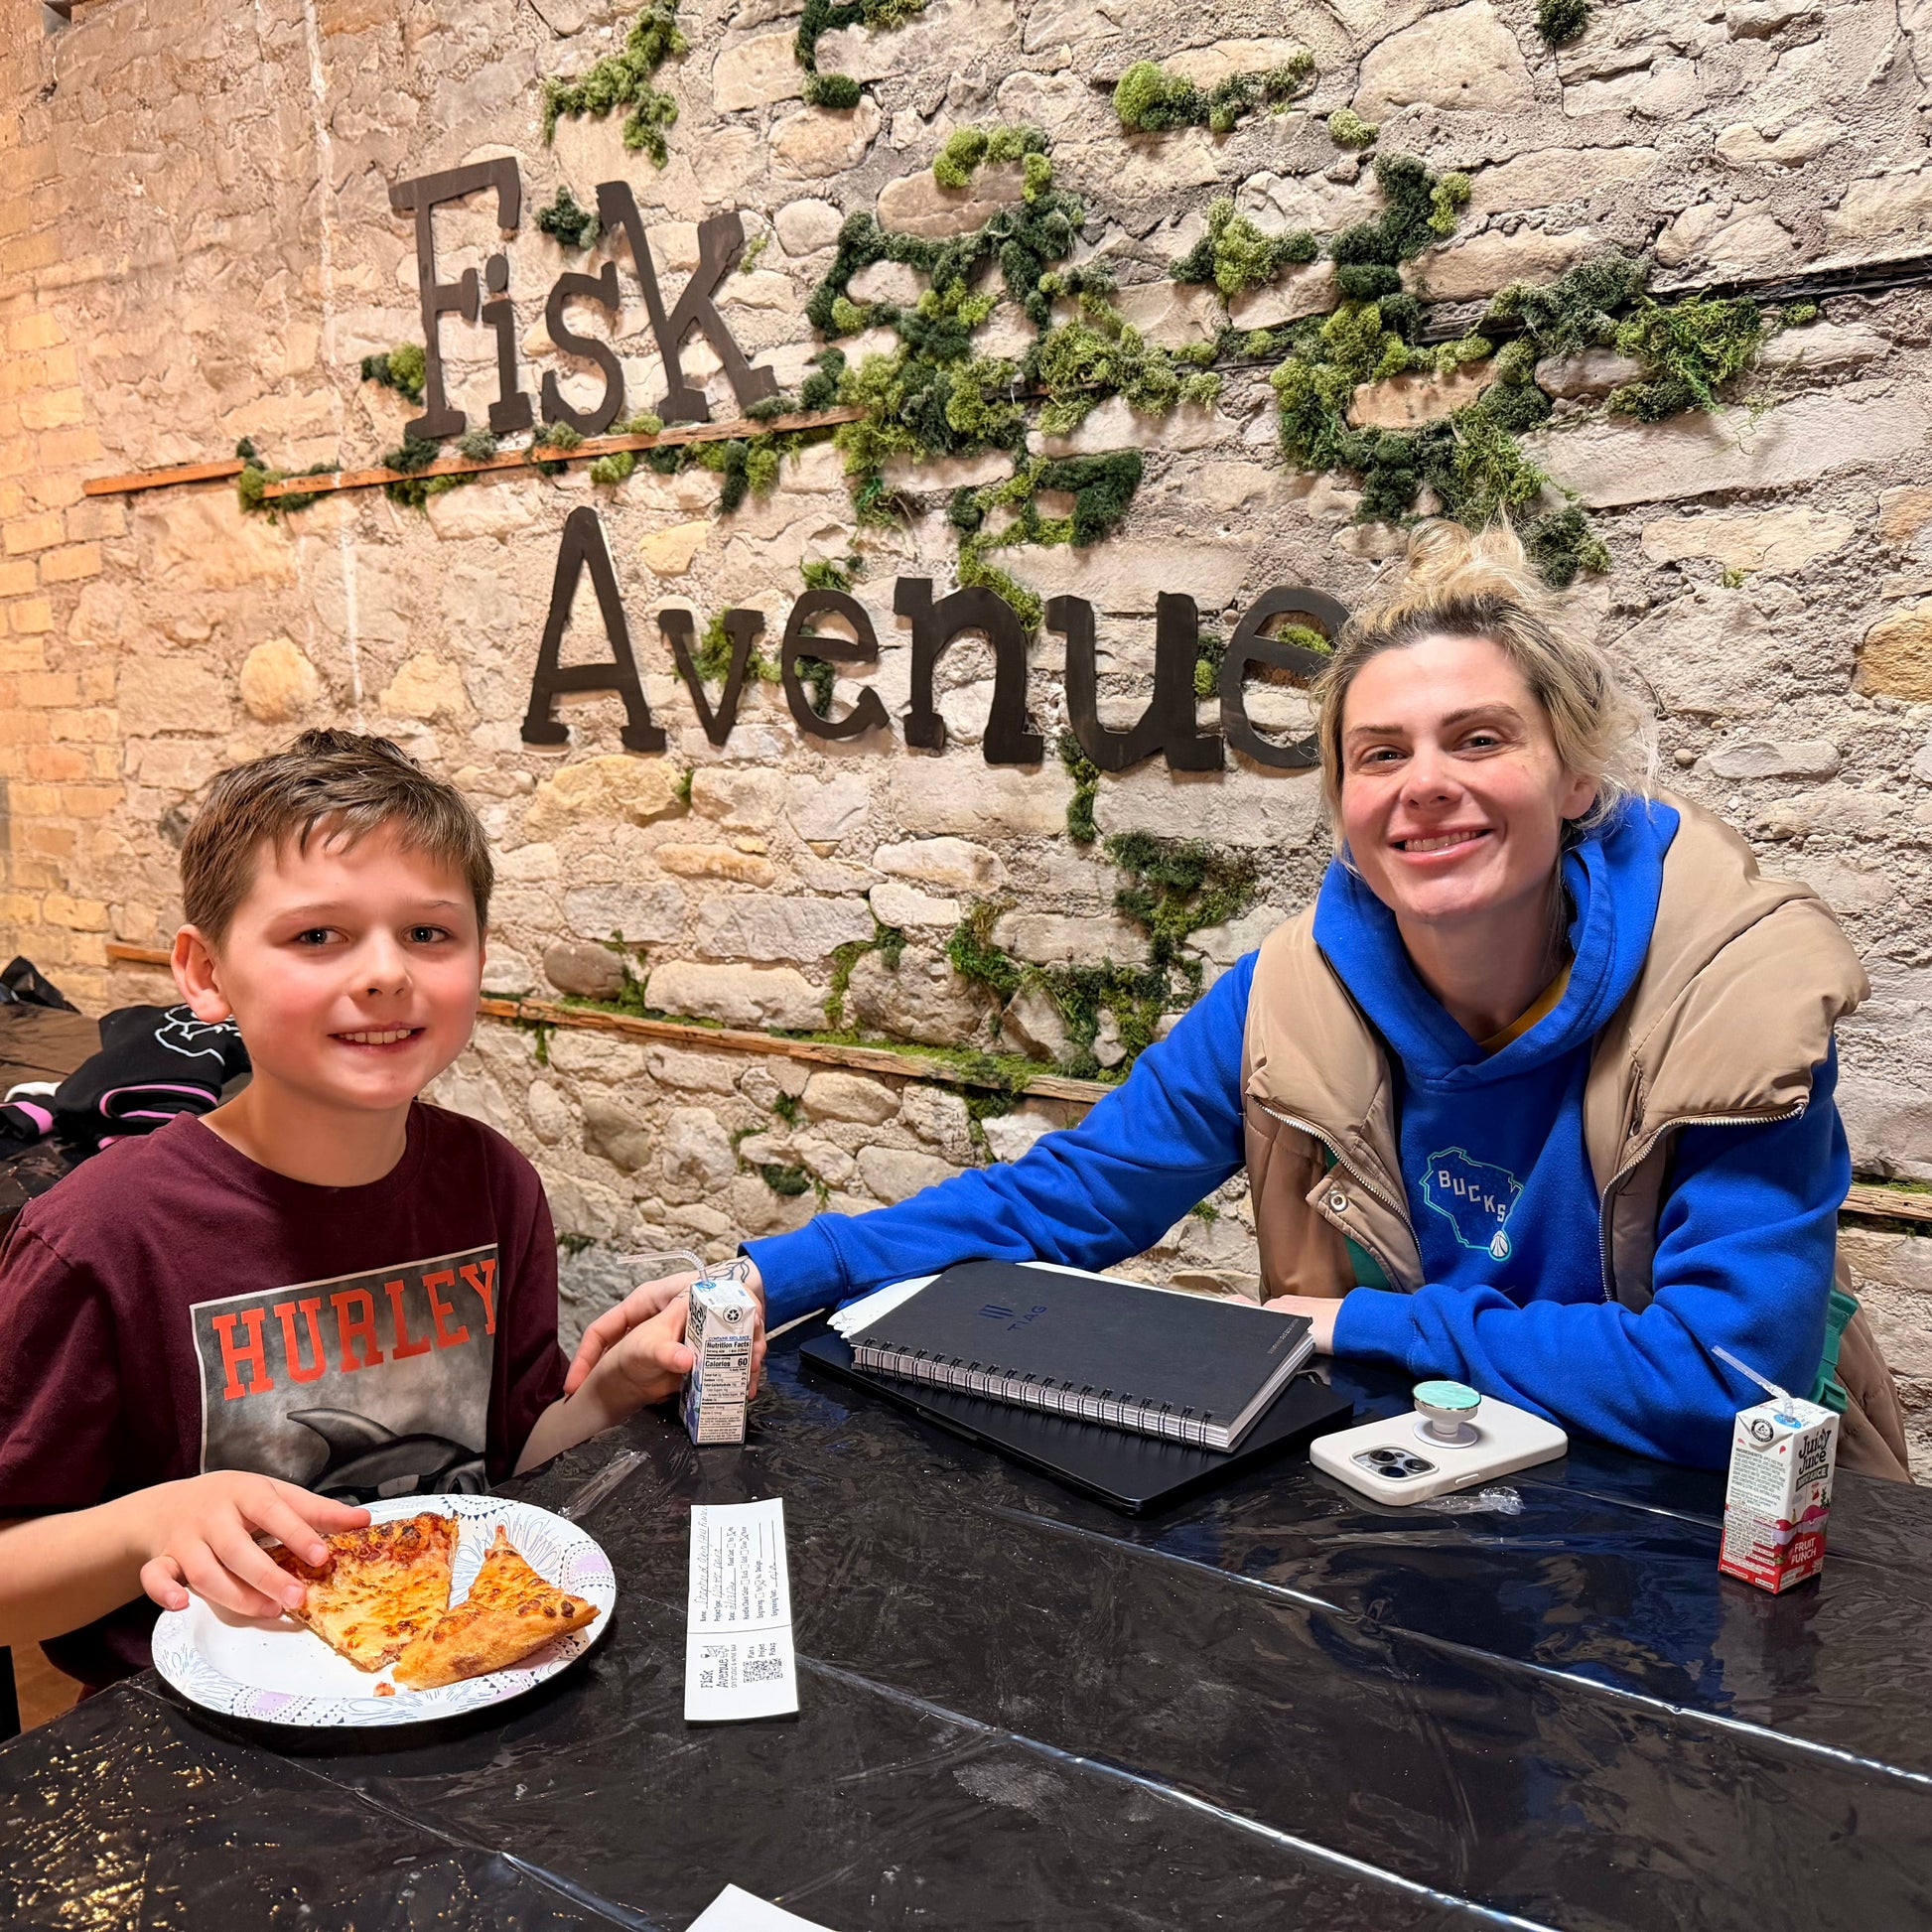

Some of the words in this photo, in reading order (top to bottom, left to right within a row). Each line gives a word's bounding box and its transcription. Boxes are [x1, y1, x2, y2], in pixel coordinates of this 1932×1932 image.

[388, 156, 779, 439] Fisk
[521, 505, 1352, 773] Avenue
[1438, 1170, 1507, 1222] BUCKS
[211, 1258, 496, 1401] HURLEY
[1007, 1305, 1047, 1331] TIAG
[738, 1357, 748, 1367] 60
[1798, 1428, 1832, 1459] Juicy
[1798, 1450, 1828, 1475] Juice
[1790, 1547, 1817, 1565] PUNCH
[1794, 1537, 1817, 1553] FRUIT
[699, 1670, 714, 1688] Fisk
[716, 1658, 729, 1688] Avenue
